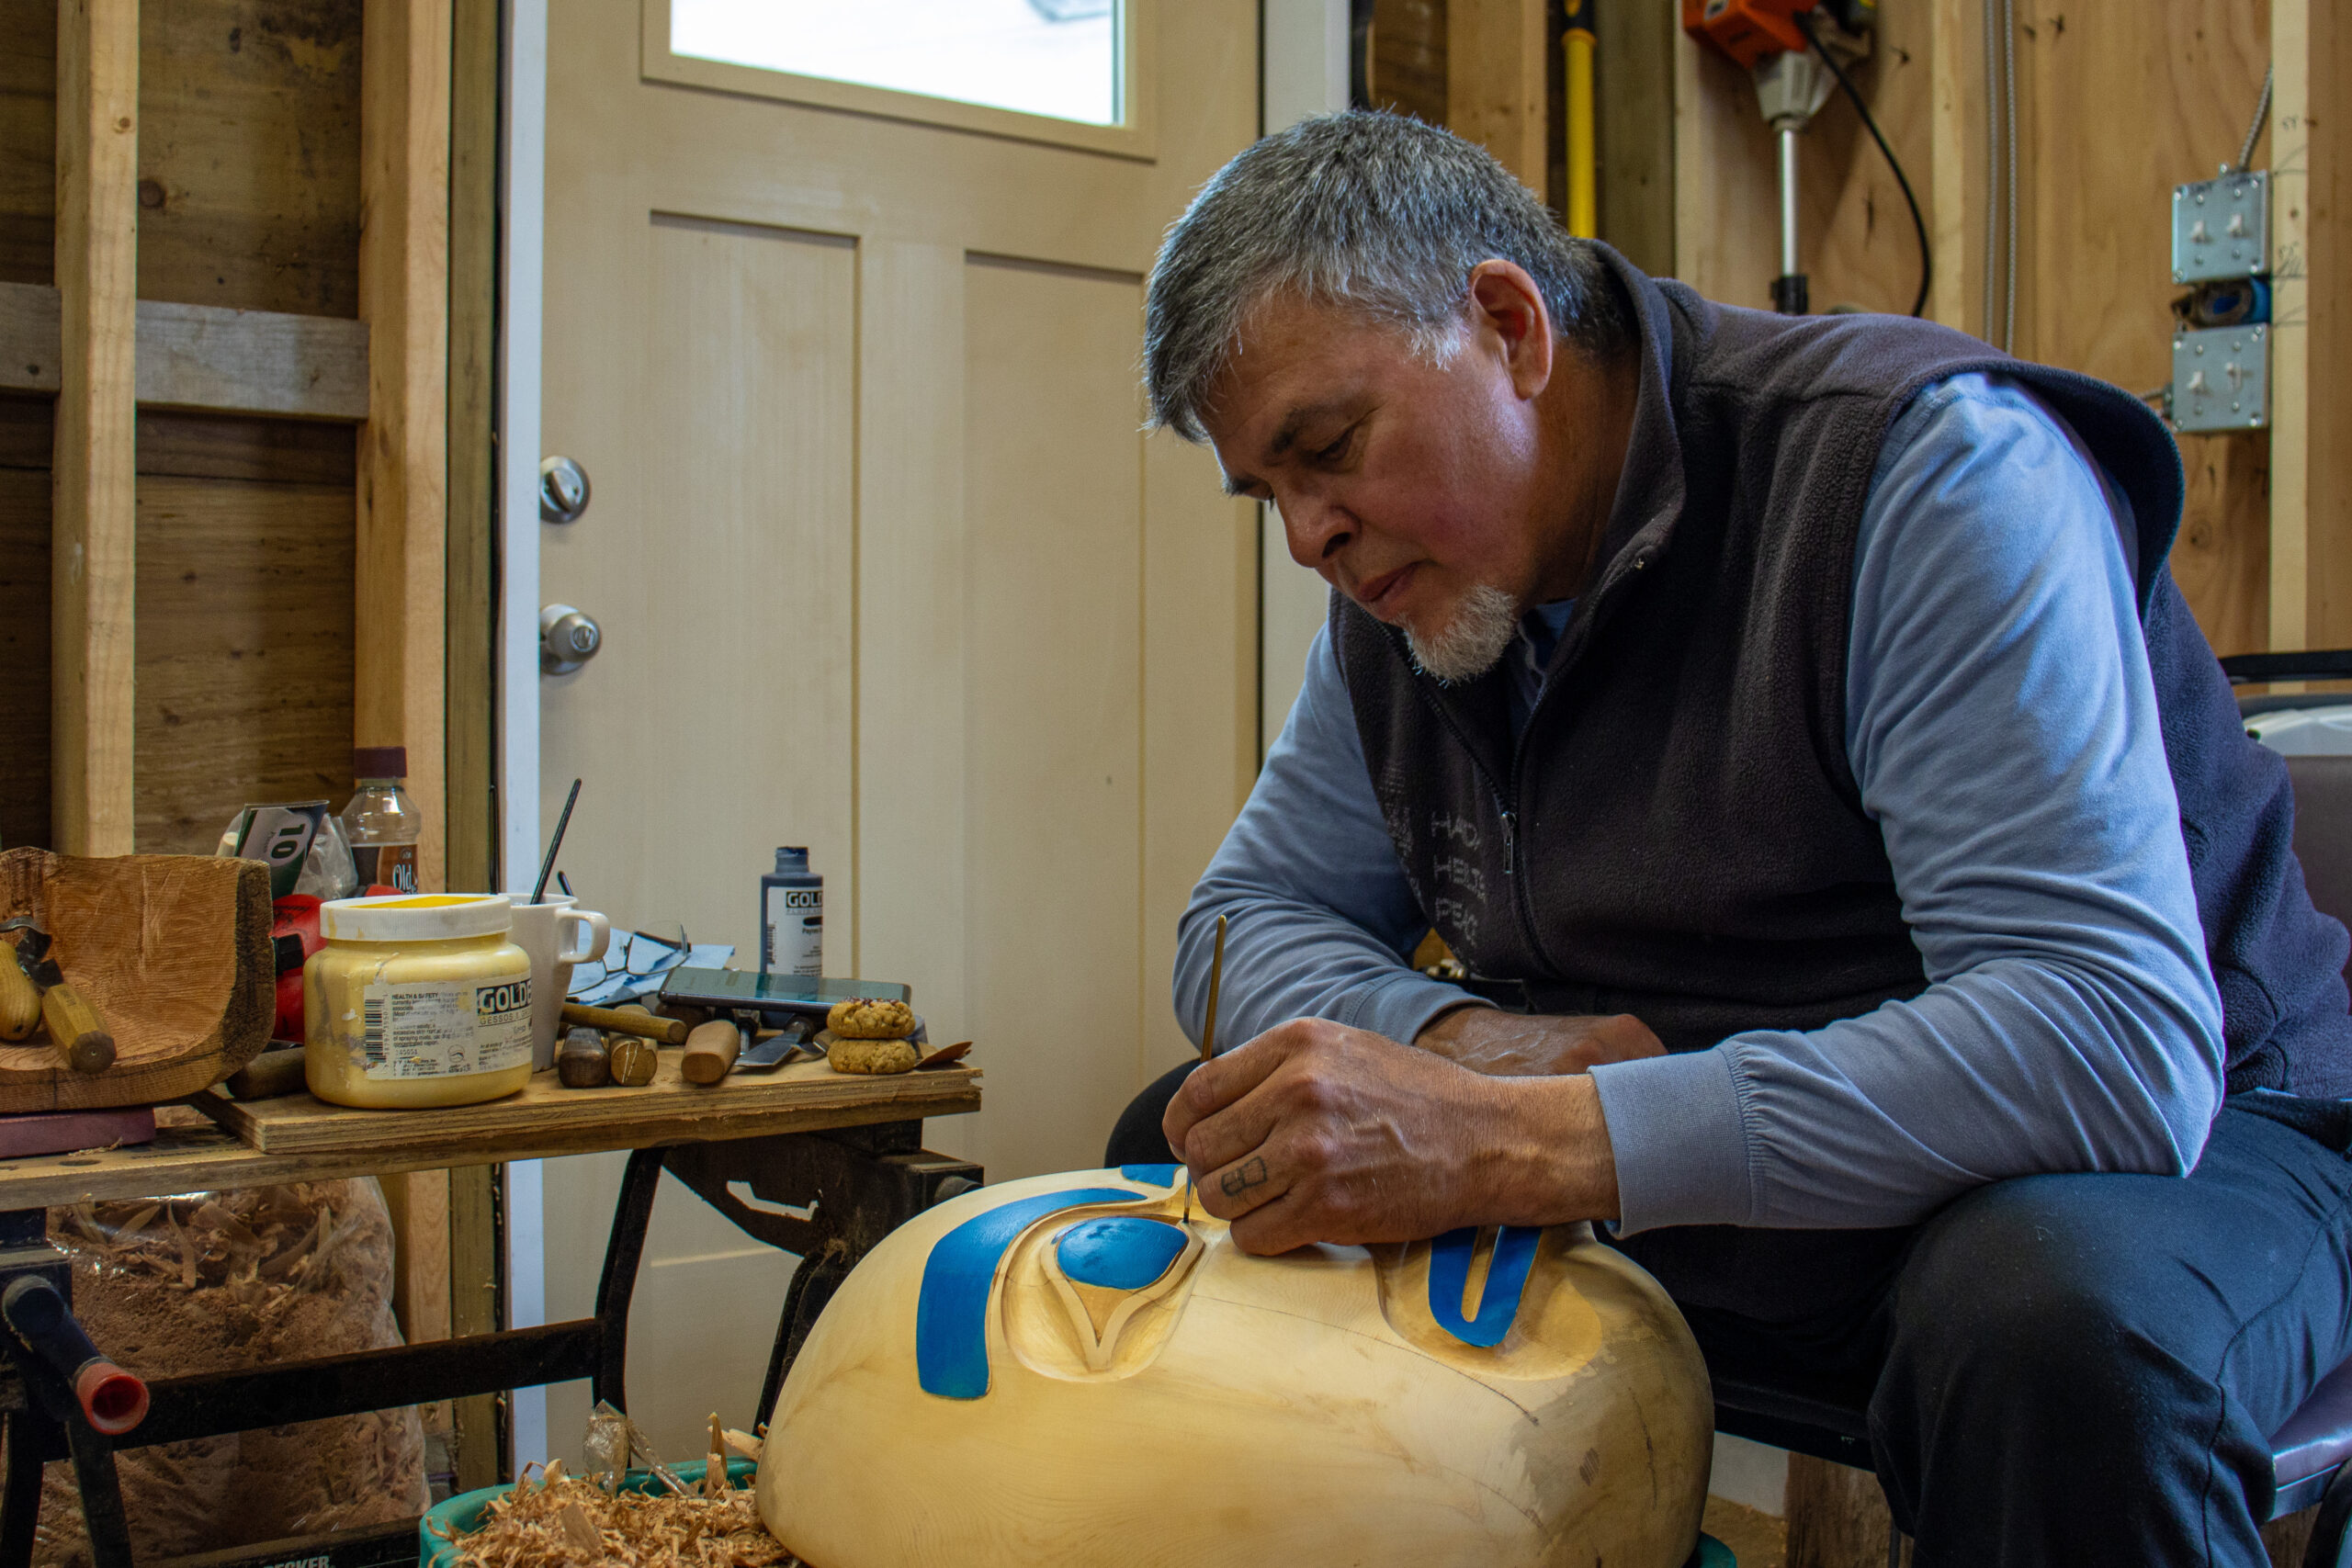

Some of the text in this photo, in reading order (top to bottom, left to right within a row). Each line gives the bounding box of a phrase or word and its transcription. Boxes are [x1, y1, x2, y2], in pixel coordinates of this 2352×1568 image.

[271, 823, 305, 859] 10
[393, 863, 412, 890] Old
[480, 1012, 514, 1025] GESSOS
[264, 1555, 329, 1568] KER
